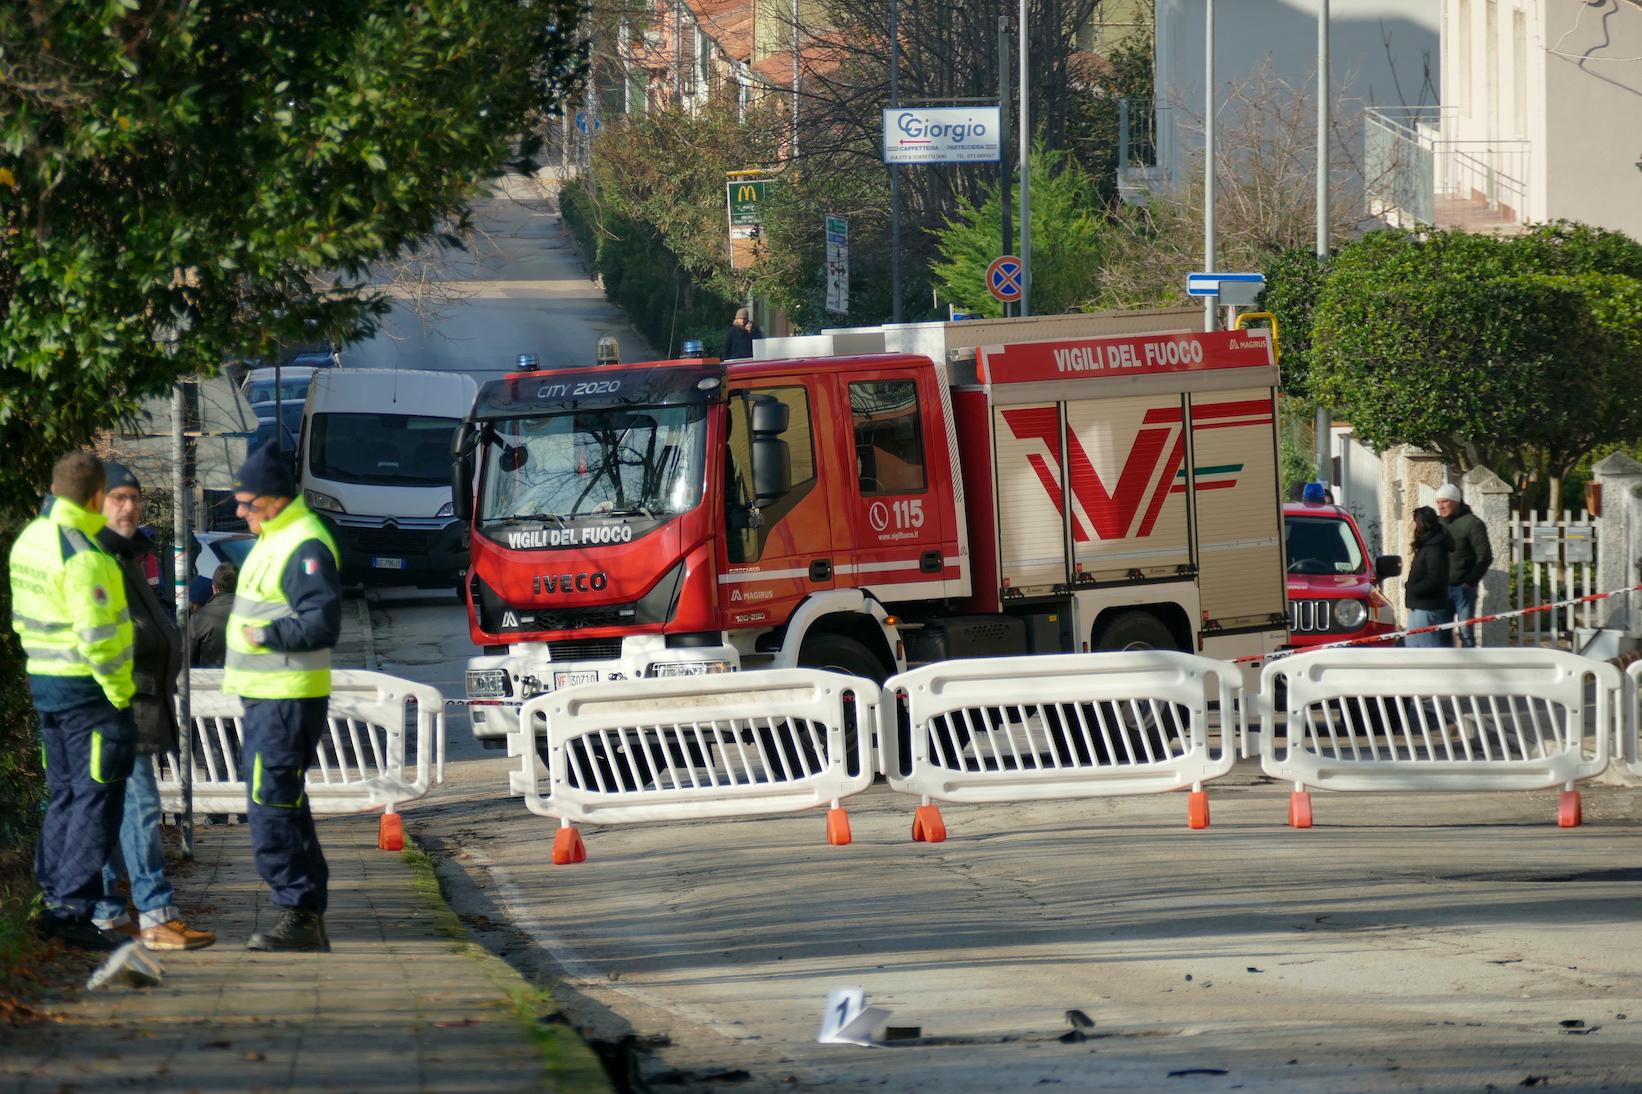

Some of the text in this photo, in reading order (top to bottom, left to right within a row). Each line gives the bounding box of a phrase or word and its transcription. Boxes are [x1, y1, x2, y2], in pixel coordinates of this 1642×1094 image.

[1053, 340, 1204, 372] VIGILI DEL FUOCO
[1239, 341, 1266, 349] MAGIRUS
[537, 380, 621, 398] CITY 2020
[893, 500, 925, 529] 115
[508, 526, 632, 549] VIGILI DEL FUOCO
[533, 571, 608, 595] IVECO
[743, 590, 774, 600] MAGIRUS
[835, 997, 850, 1026] 1
